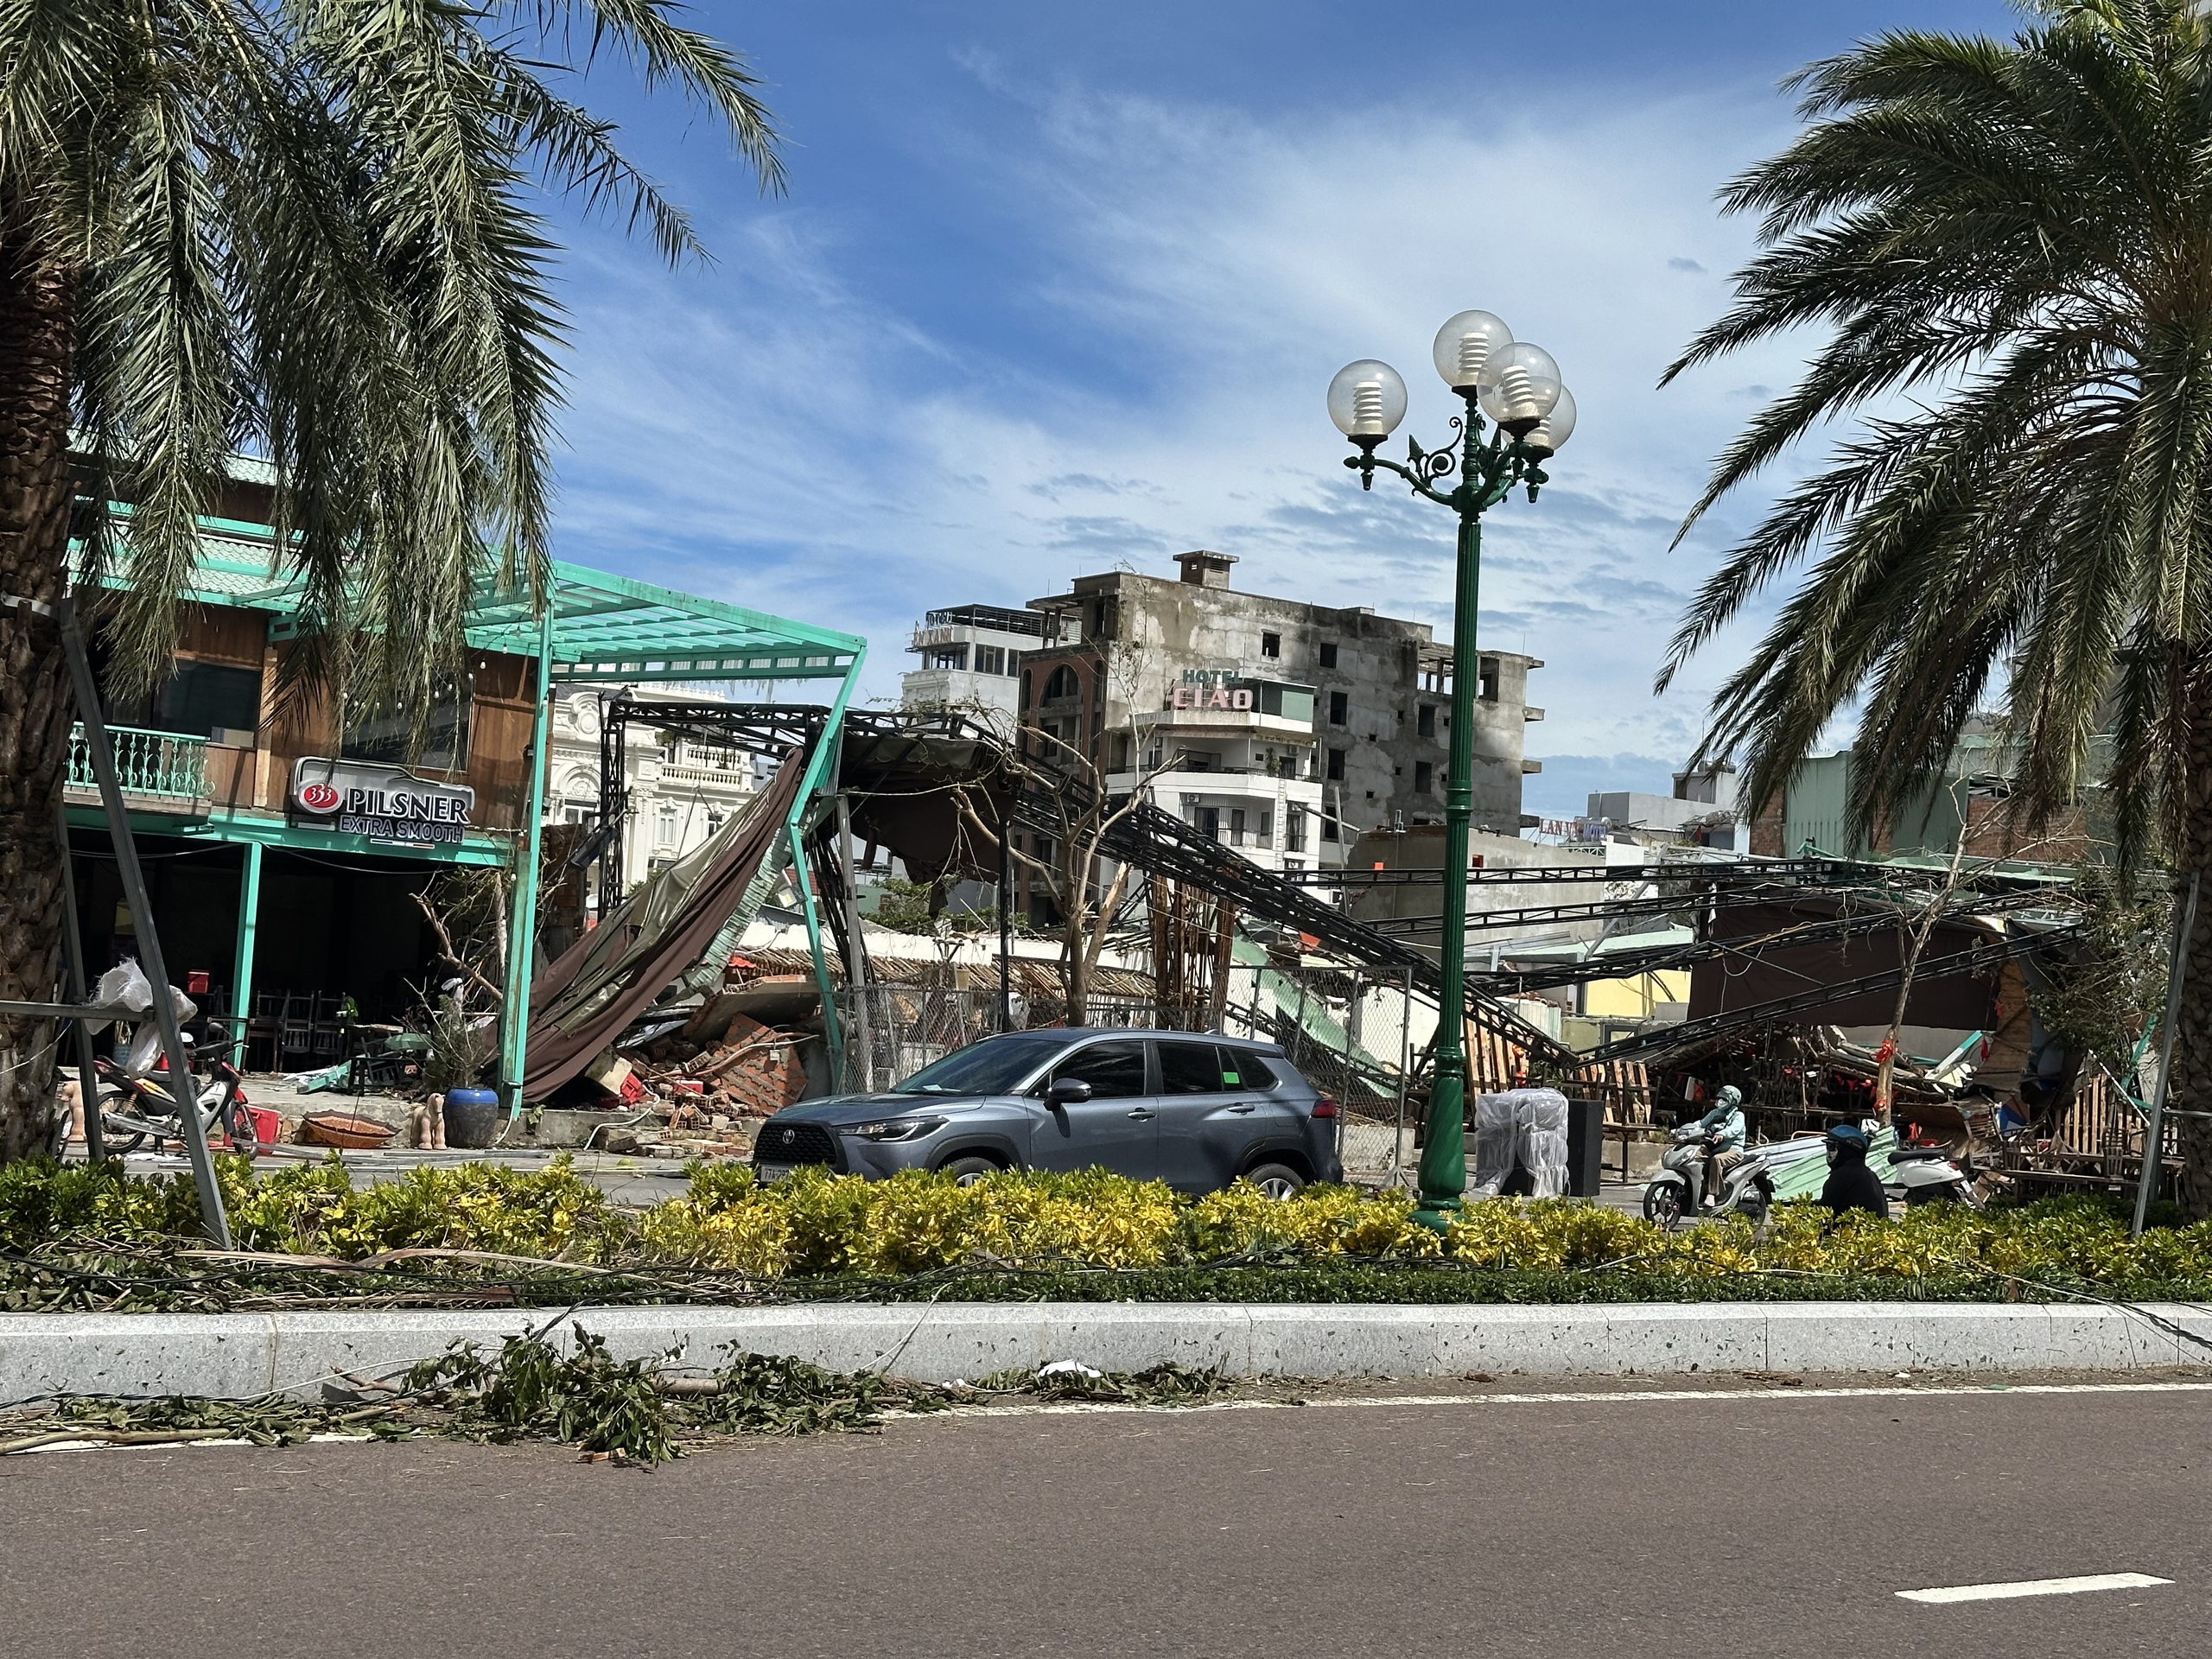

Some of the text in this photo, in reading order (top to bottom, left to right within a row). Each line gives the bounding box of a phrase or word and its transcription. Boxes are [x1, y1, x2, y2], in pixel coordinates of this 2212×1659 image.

[1183, 670, 1243, 684] HOTEL
[1173, 688, 1253, 709] CIAO
[308, 783, 472, 824] 333 PILSNER
[340, 815, 466, 844] EXTRA SMOOTH
[1539, 818, 1562, 836] LAN
